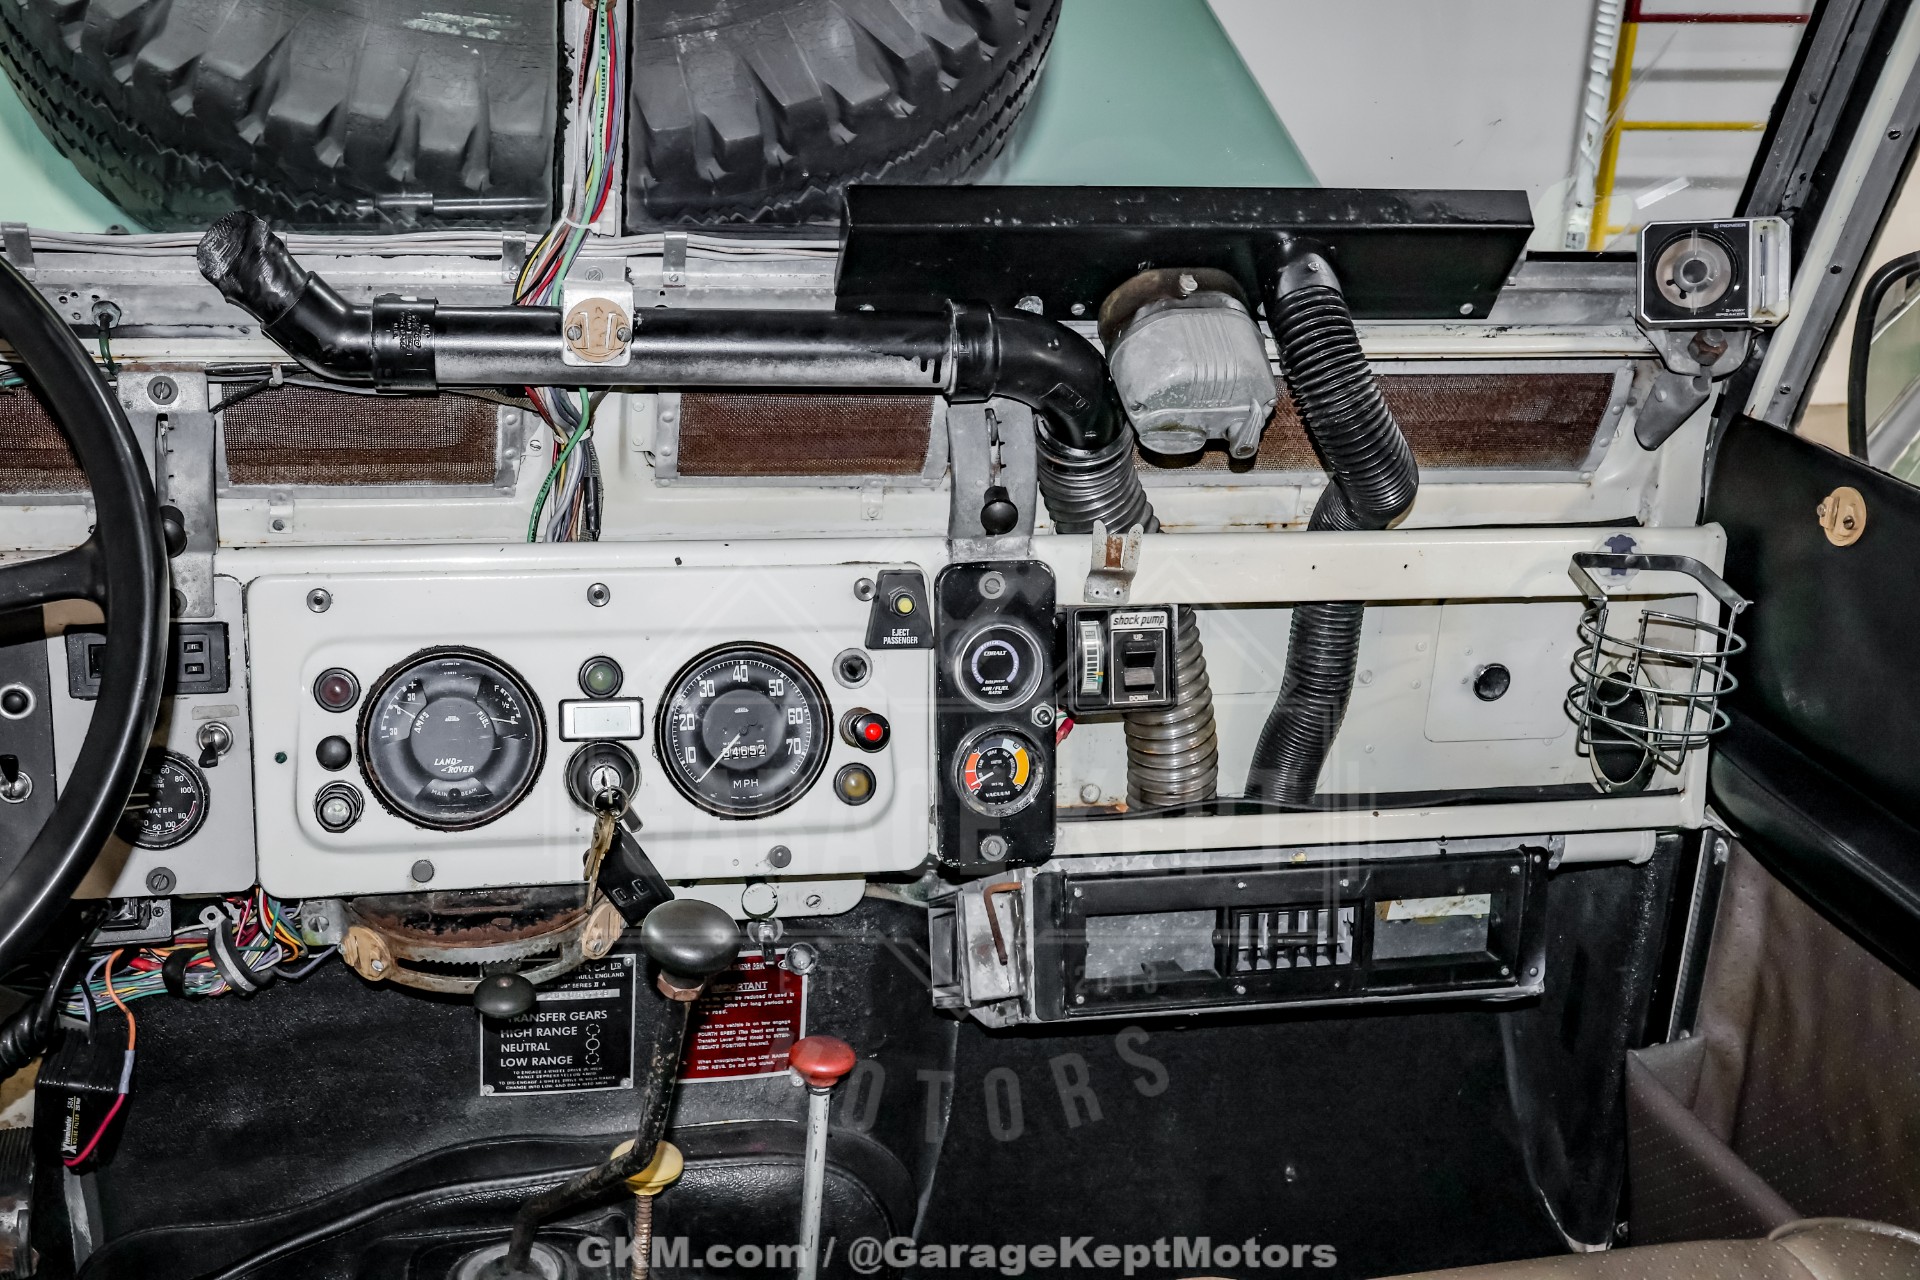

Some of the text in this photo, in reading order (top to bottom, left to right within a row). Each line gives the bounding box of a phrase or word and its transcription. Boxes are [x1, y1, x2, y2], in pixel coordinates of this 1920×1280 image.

[1113, 615, 1165, 626] shock pump
[891, 628, 910, 637] EJECT
[883, 636, 918, 645] PASSENGER
[732, 665, 748, 682] 40
[698, 679, 715, 698] 30
[768, 678, 784, 697] 50
[407, 692, 416, 701] 30
[414, 711, 430, 734] AMPS
[476, 710, 490, 729] FUEL
[678, 713, 695, 731] 20
[787, 707, 804, 725] 60
[389, 727, 397, 736] 30
[786, 737, 802, 755] 70
[684, 746, 697, 764] 10
[434, 758, 456, 766] LAND
[447, 766, 474, 774] ROVER
[733, 779, 759, 789] MPH
[431, 787, 478, 797] MAIN BEAM
[711, 981, 768, 991] IMPORTANT
[508, 1010, 608, 1023] TRANSFER GEARS
[500, 1026, 578, 1039] HIGH RANGE
[500, 1042, 550, 1053] NEUTRAL
[500, 1055, 573, 1068] LOW RANGE
